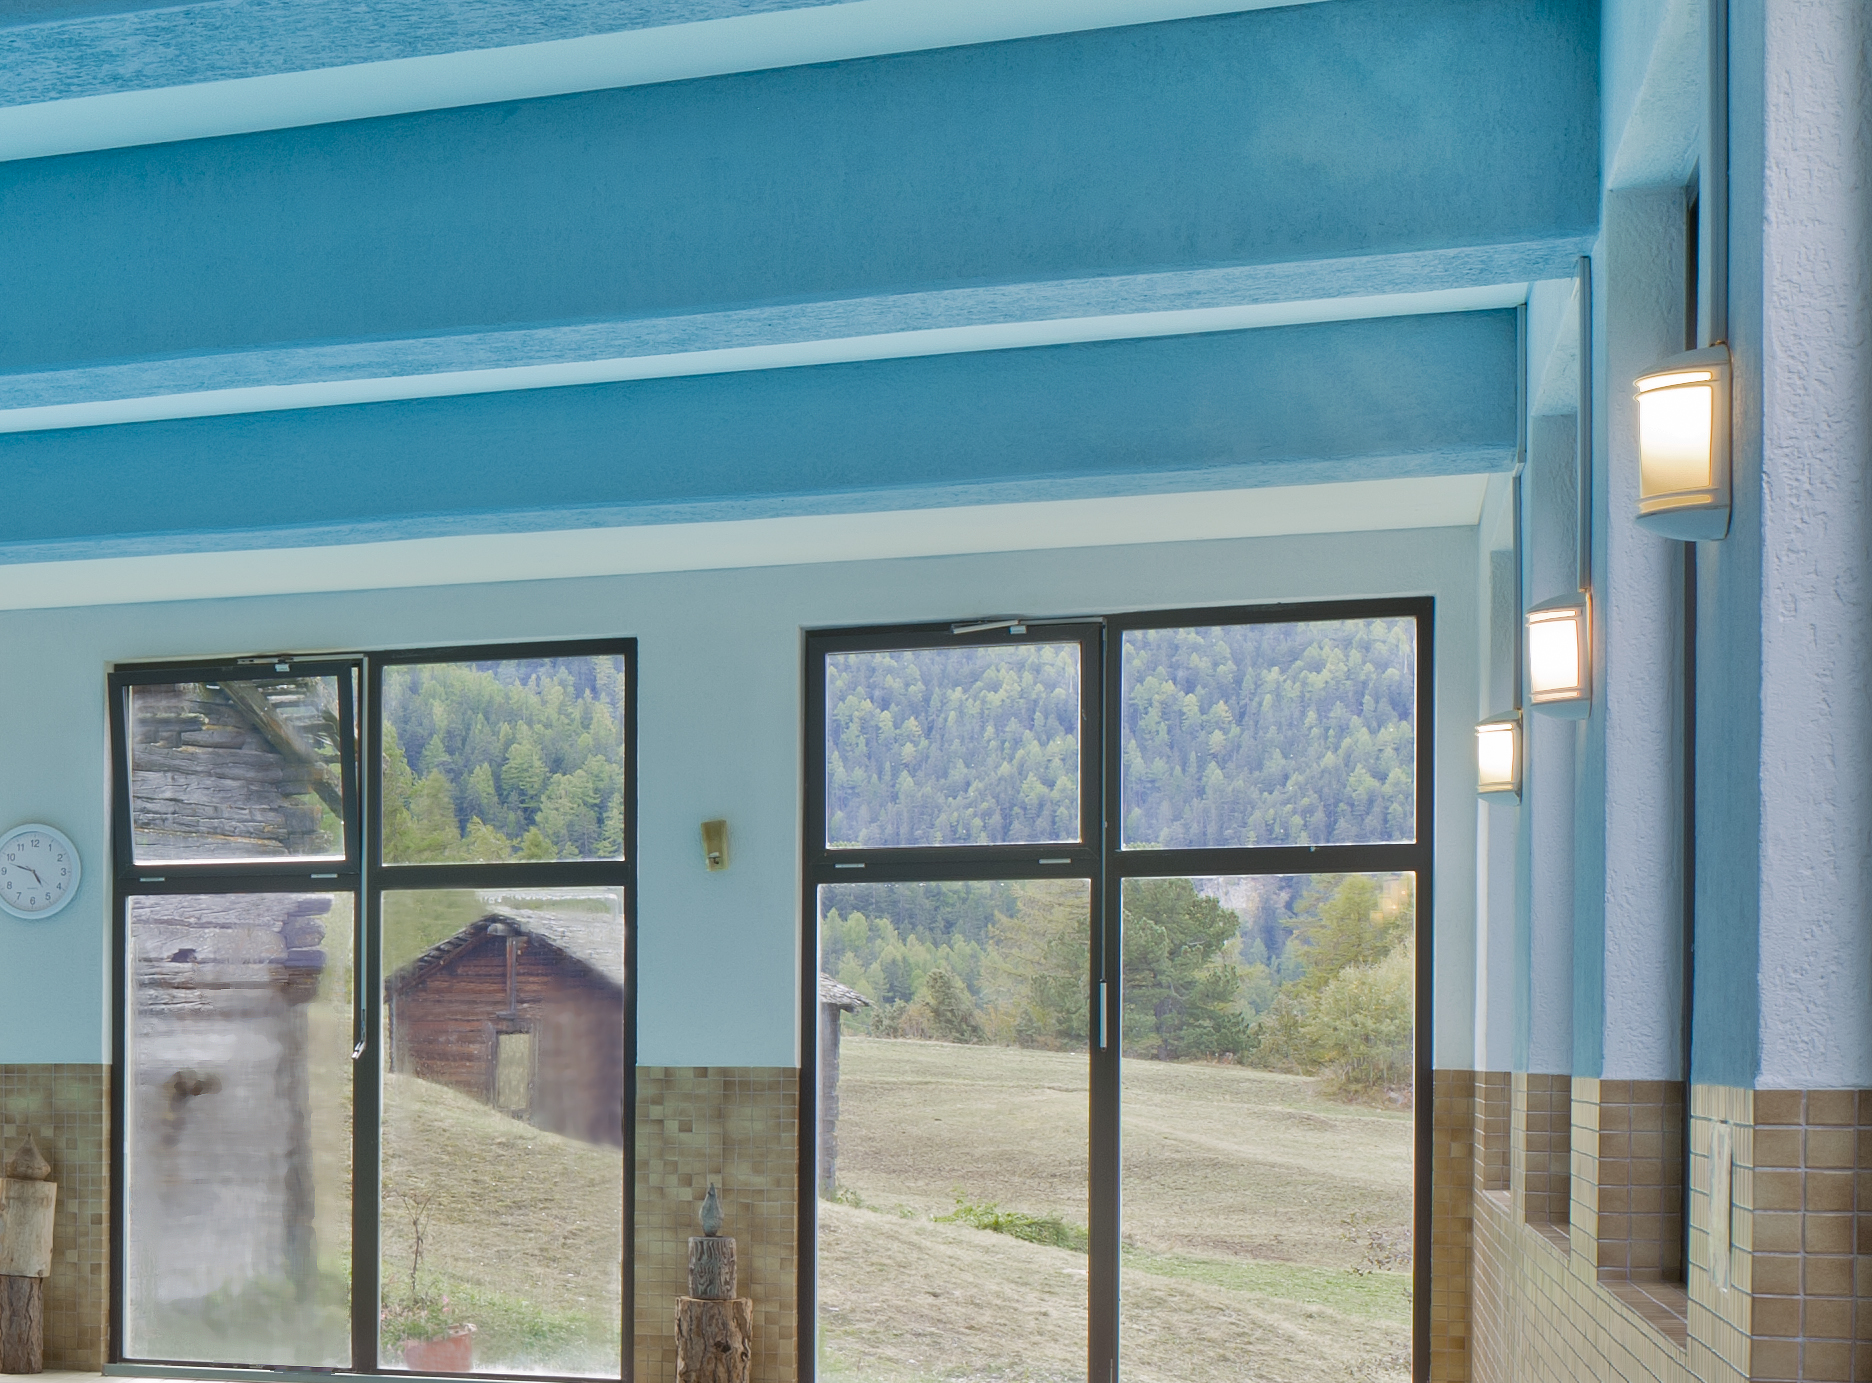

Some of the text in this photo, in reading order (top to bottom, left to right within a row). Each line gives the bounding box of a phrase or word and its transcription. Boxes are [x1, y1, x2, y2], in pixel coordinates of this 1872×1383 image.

[17, 843, 24, 851] 11
[31, 839, 40, 848] 12
[48, 843, 52, 852] 1
[7, 853, 16, 861] 10
[57, 853, 63, 862] 2
[1, 867, 7, 875] 9
[60, 867, 67, 876] 3
[6, 881, 12, 890] 8
[56, 882, 62, 890] 4
[16, 891, 22, 900] 7
[45, 892, 51, 901] 5
[29, 896, 36, 905] 6
